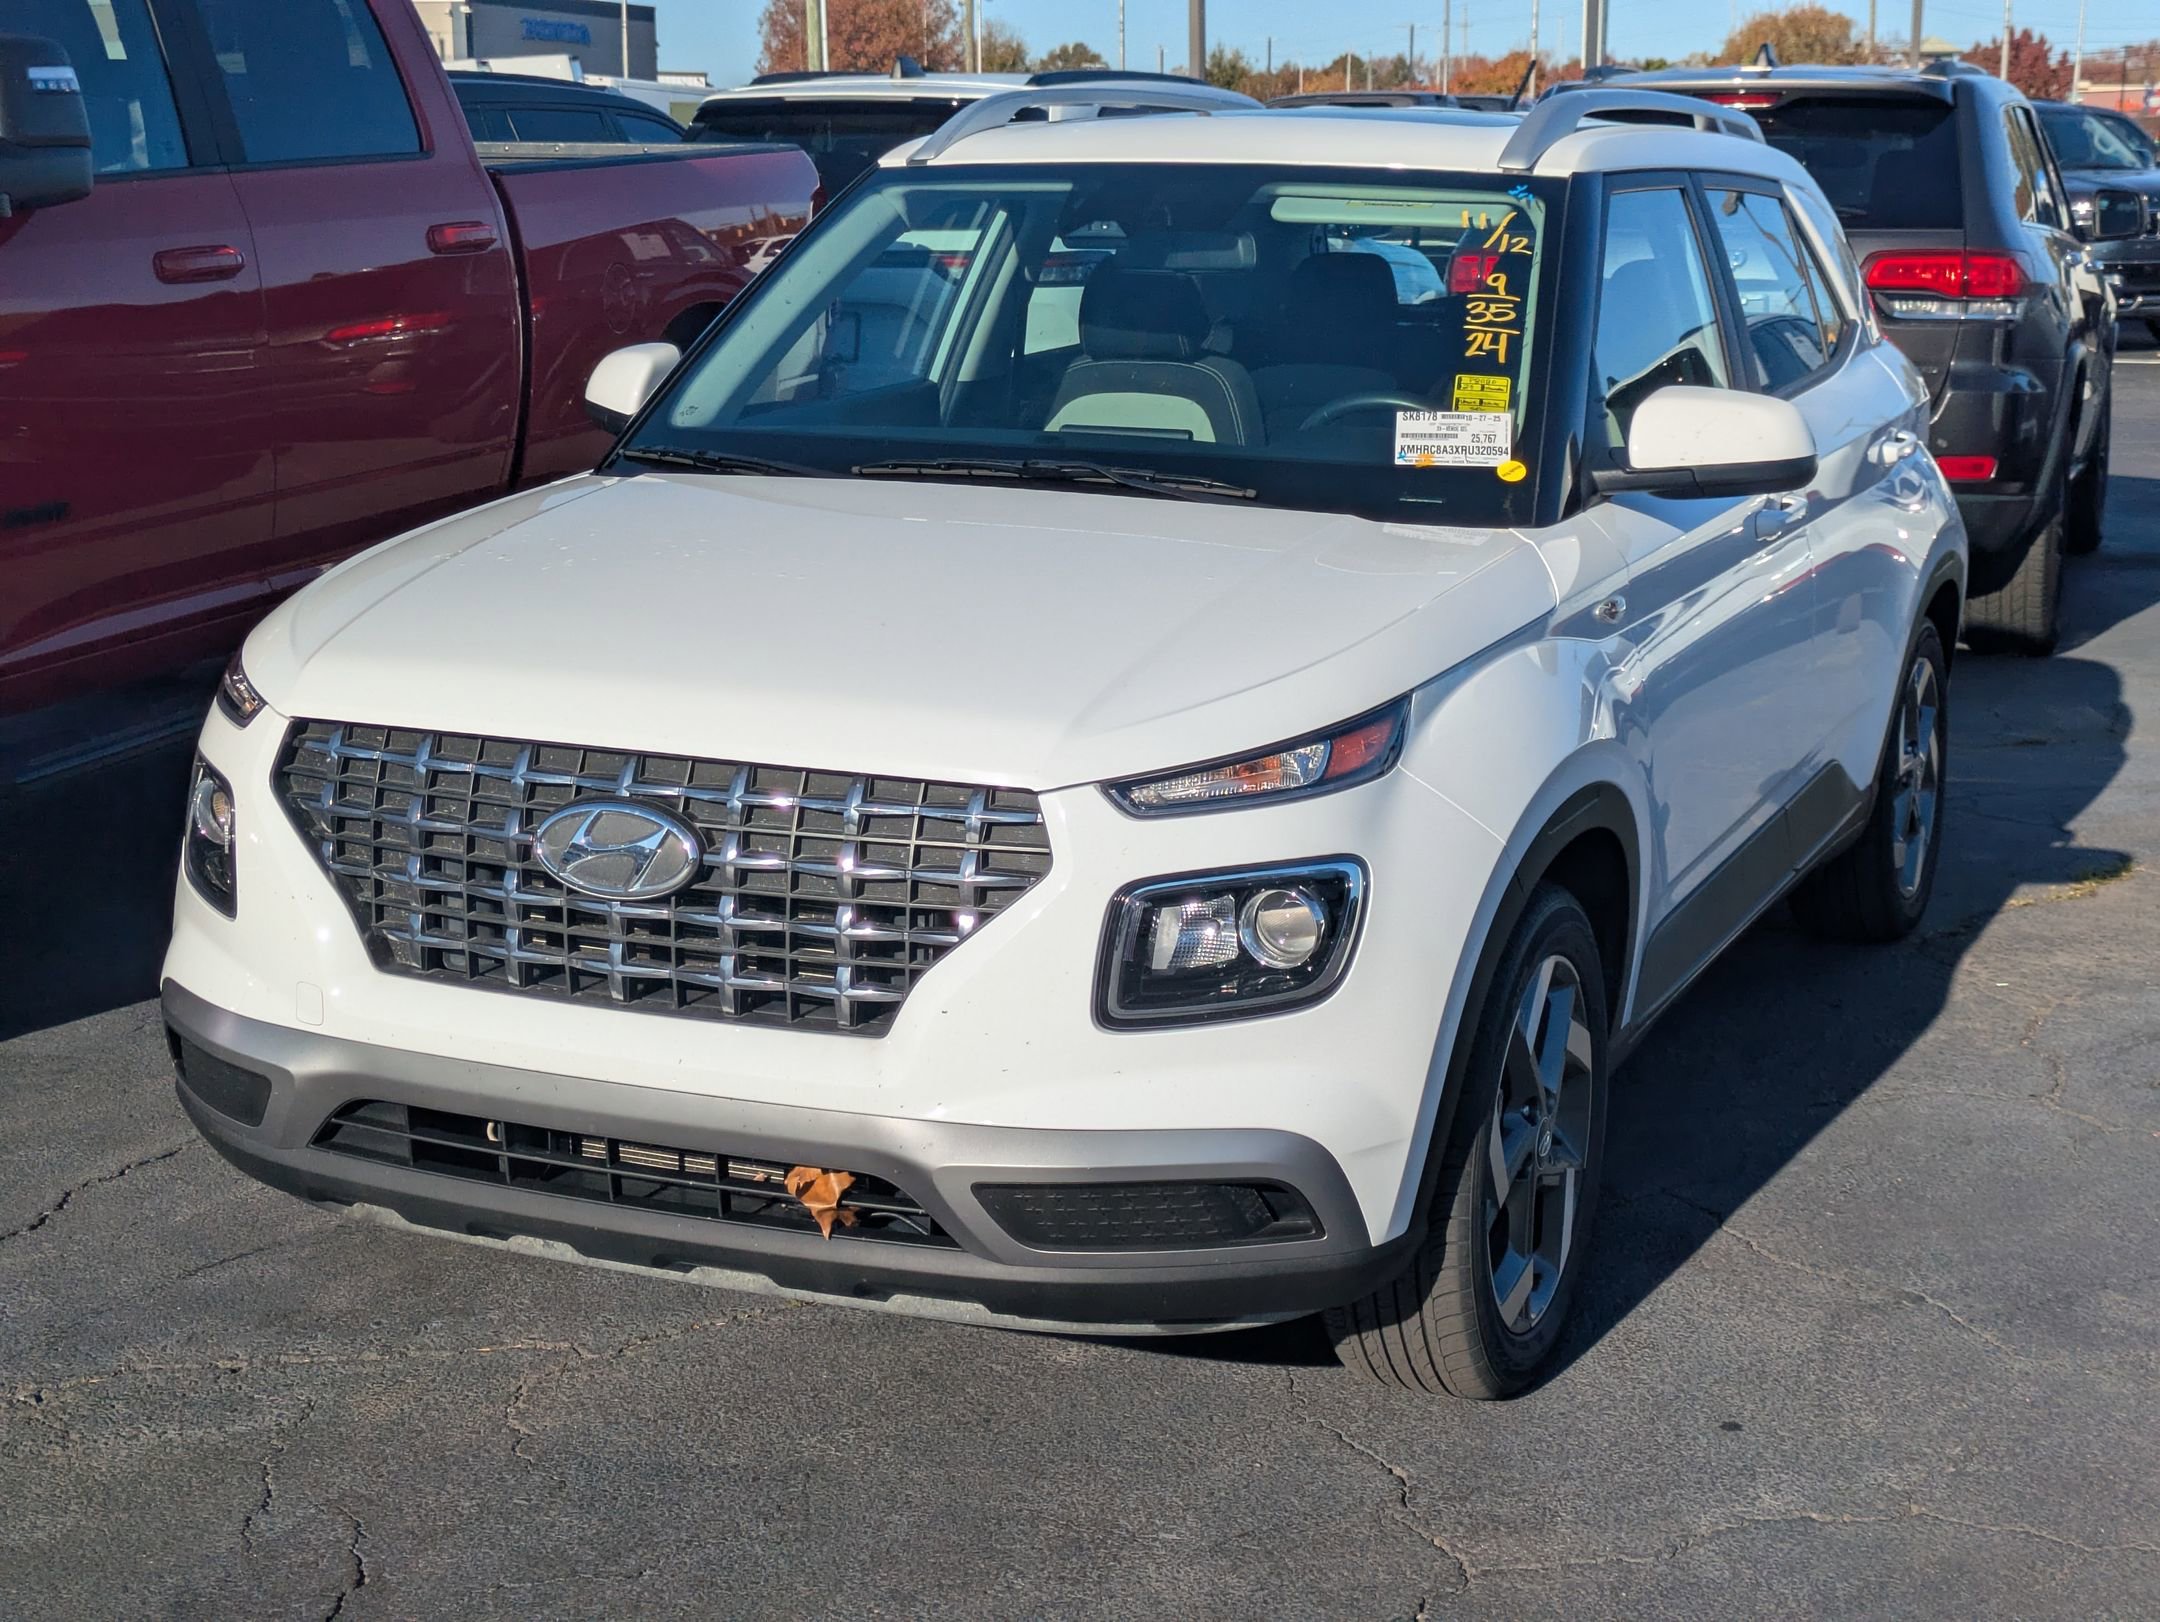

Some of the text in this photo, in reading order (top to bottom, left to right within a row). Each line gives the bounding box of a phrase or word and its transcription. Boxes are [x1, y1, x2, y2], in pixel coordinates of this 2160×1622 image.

[1466, 301, 1517, 323] 35
[1465, 332, 1508, 364] 24
[1402, 411, 1438, 421] SK8178
[1471, 433, 1497, 443] 25,767
[1400, 444, 1509, 456] KMHRC8A3XRU320594
